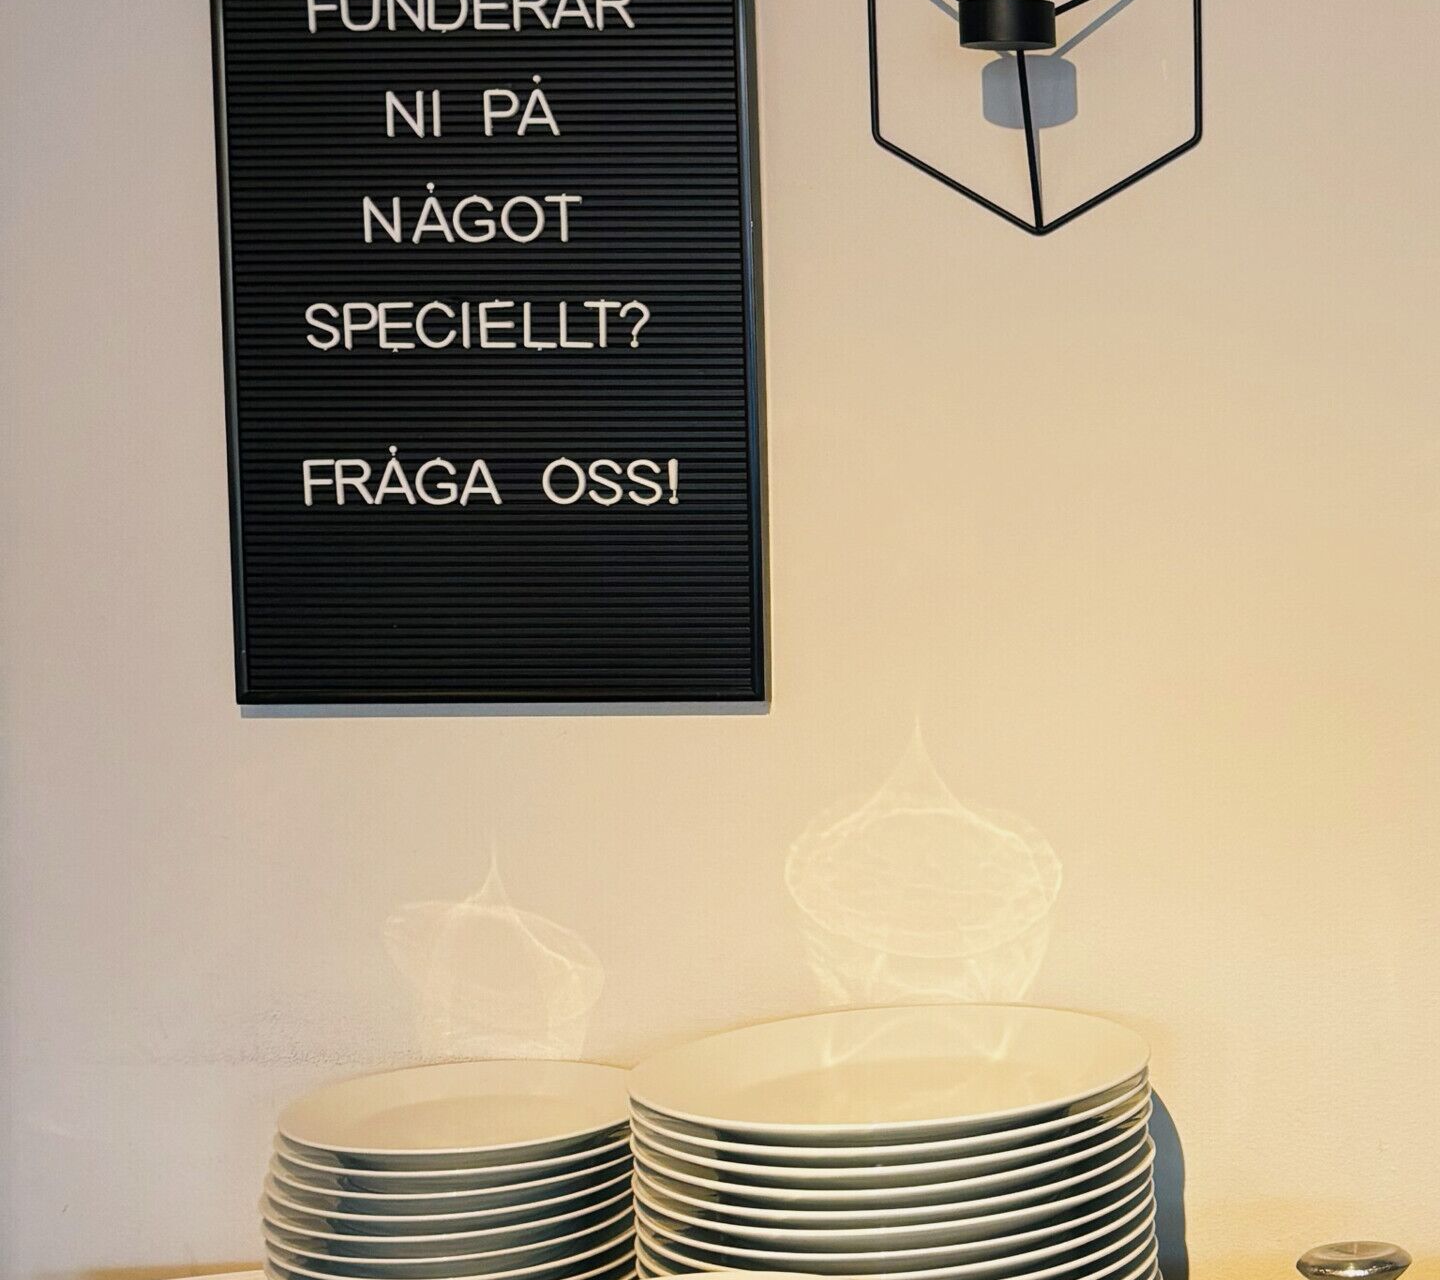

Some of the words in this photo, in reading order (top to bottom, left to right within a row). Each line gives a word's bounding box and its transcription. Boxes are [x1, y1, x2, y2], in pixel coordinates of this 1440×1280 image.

[385, 89, 441, 138] NI
[483, 74, 560, 137] PÅ
[362, 182, 583, 244] NÅGOT
[305, 298, 650, 353] SPECIELLT?
[302, 445, 503, 507] FRÅGA
[542, 456, 679, 507] OSS!
